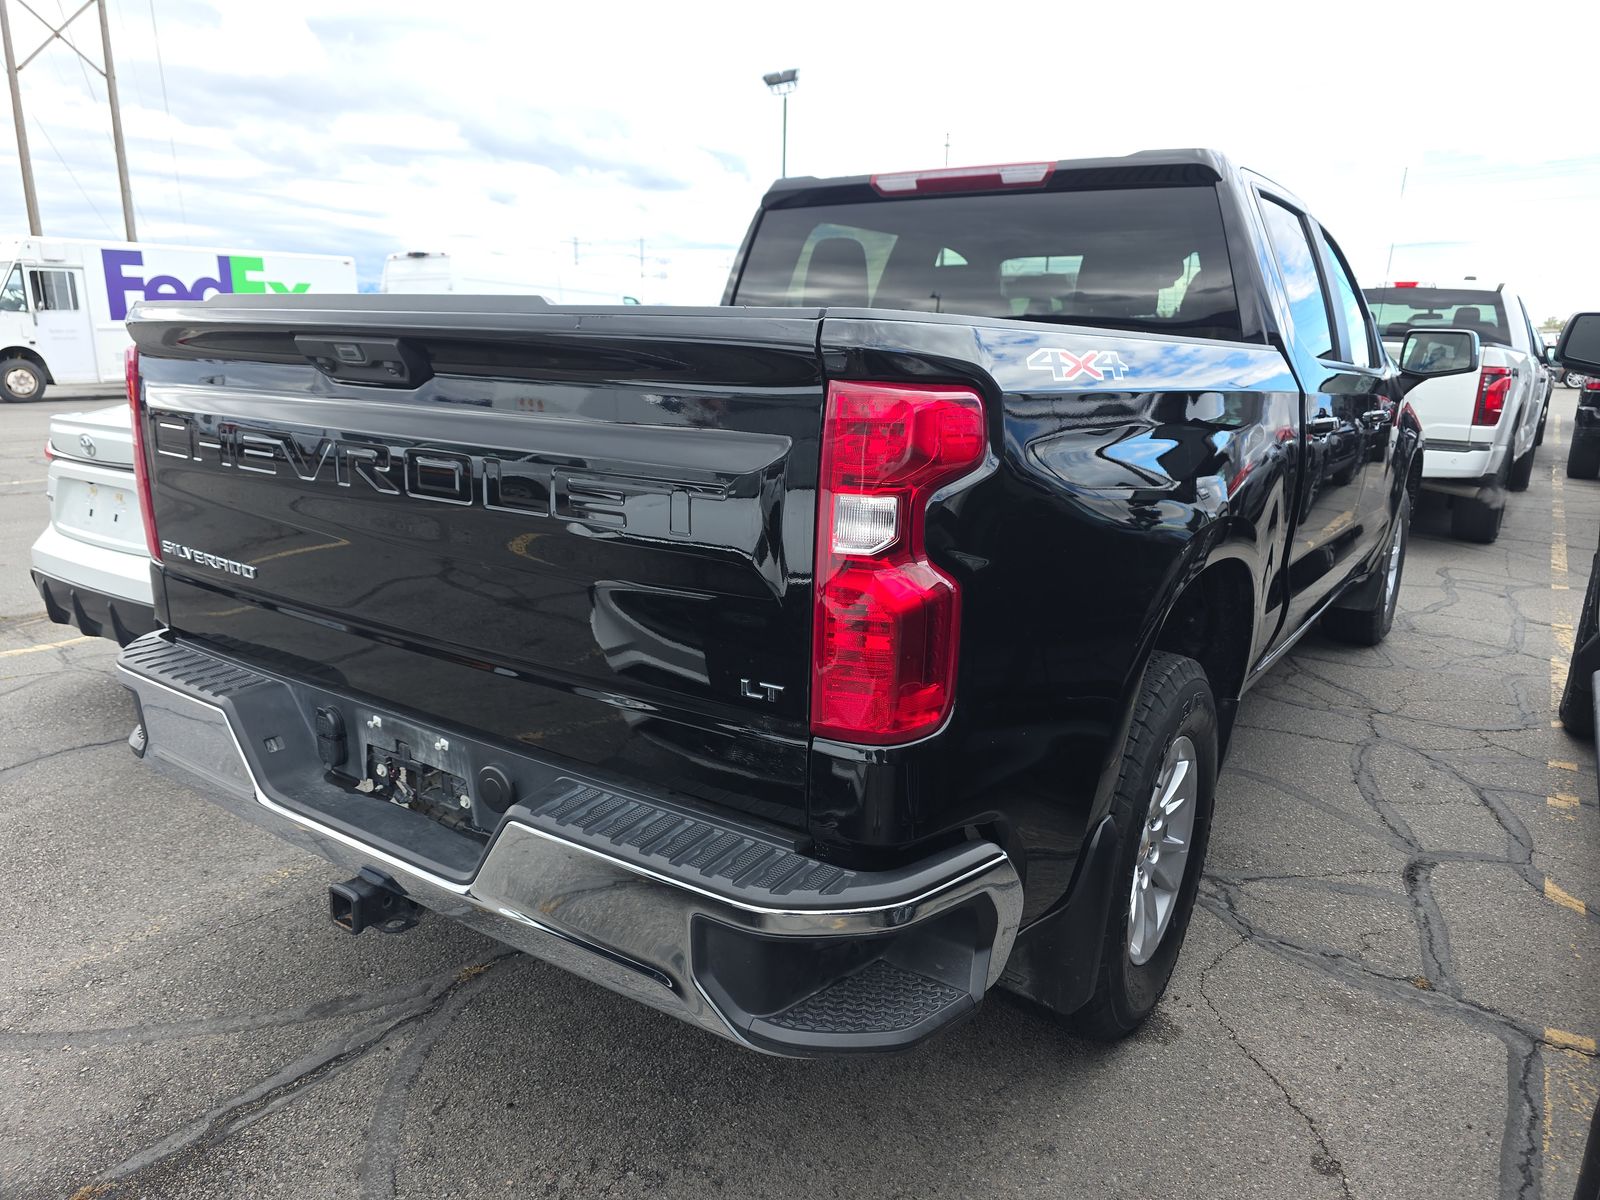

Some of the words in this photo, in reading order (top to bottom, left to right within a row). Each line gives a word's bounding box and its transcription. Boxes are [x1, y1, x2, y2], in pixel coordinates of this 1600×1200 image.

[101, 249, 311, 320] FedE
[157, 414, 730, 536] CHEVROLET
[162, 541, 257, 579] SILVERADO
[740, 678, 785, 701] LT
